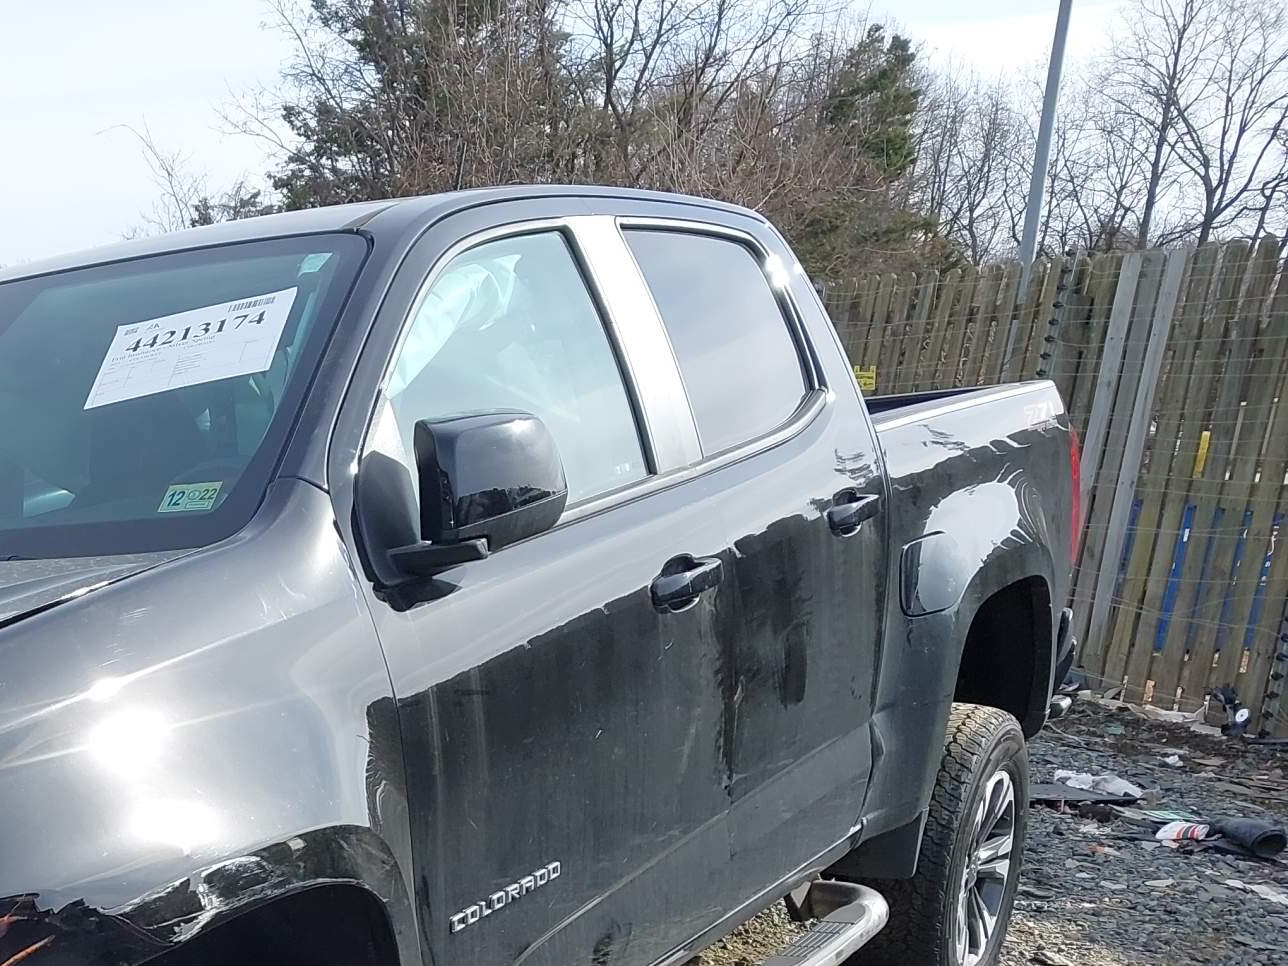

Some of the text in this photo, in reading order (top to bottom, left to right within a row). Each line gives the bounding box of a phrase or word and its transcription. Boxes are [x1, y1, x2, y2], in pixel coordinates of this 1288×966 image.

[125, 311, 266, 353] 44213174
[168, 490, 185, 506] 12
[199, 488, 217, 500] 22
[449, 861, 560, 933] COLORADO
